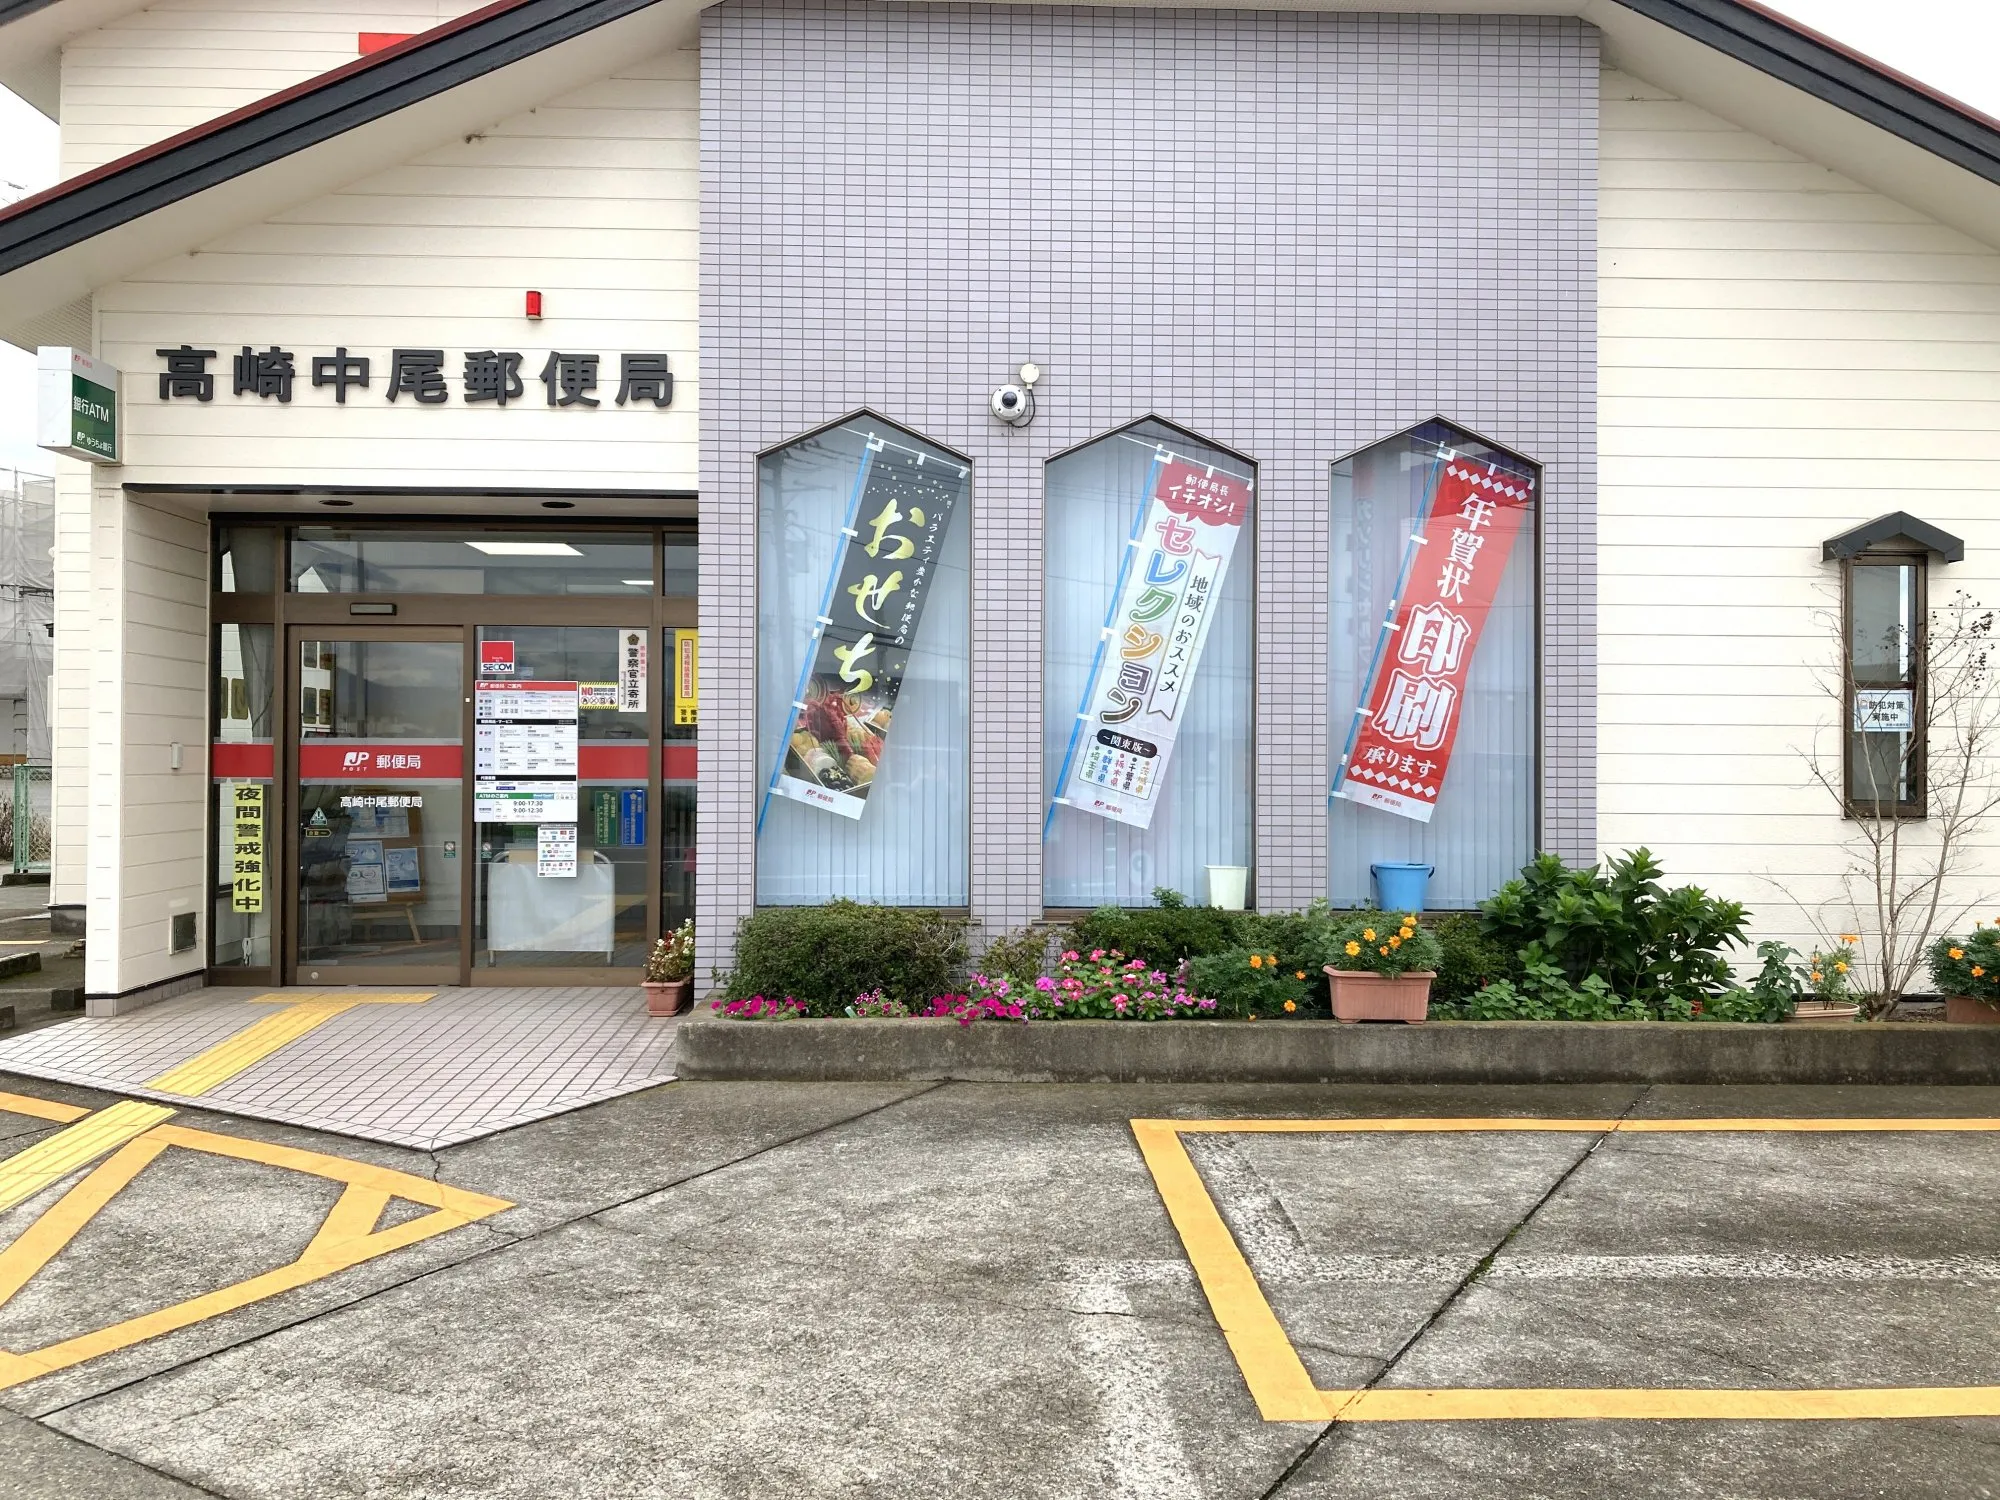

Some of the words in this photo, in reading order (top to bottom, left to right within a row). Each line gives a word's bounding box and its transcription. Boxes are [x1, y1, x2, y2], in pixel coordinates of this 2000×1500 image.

[155, 344, 674, 408] 高崎中尾郵便局
[73, 395, 109, 423] 銀行ATM
[86, 436, 113, 453] ゆうちょ銀行
[1185, 474, 1230, 496] 郵便局長
[1436, 492, 1497, 605] 年賀状
[894, 512, 943, 645] バラエティ豊かな郵便局の
[833, 498, 926, 694] おせち
[1100, 516, 1195, 724] セレクション
[1160, 575, 1209, 692] 地域のおススメ
[483, 663, 512, 671] SECOM
[627, 647, 639, 709] 警察官立寄所
[1375, 604, 1468, 748] 印刷
[581, 687, 593, 696] NO
[1869, 701, 1905, 710] 防犯対策
[376, 755, 421, 769] 郵便局
[1110, 758, 1125, 787] 栃木県
[1122, 762, 1137, 791] 千葉県
[1362, 745, 1437, 779] 承ります
[340, 796, 423, 808] 高崎中尾郵便局
[234, 787, 262, 910] 夜間警戒強化中
